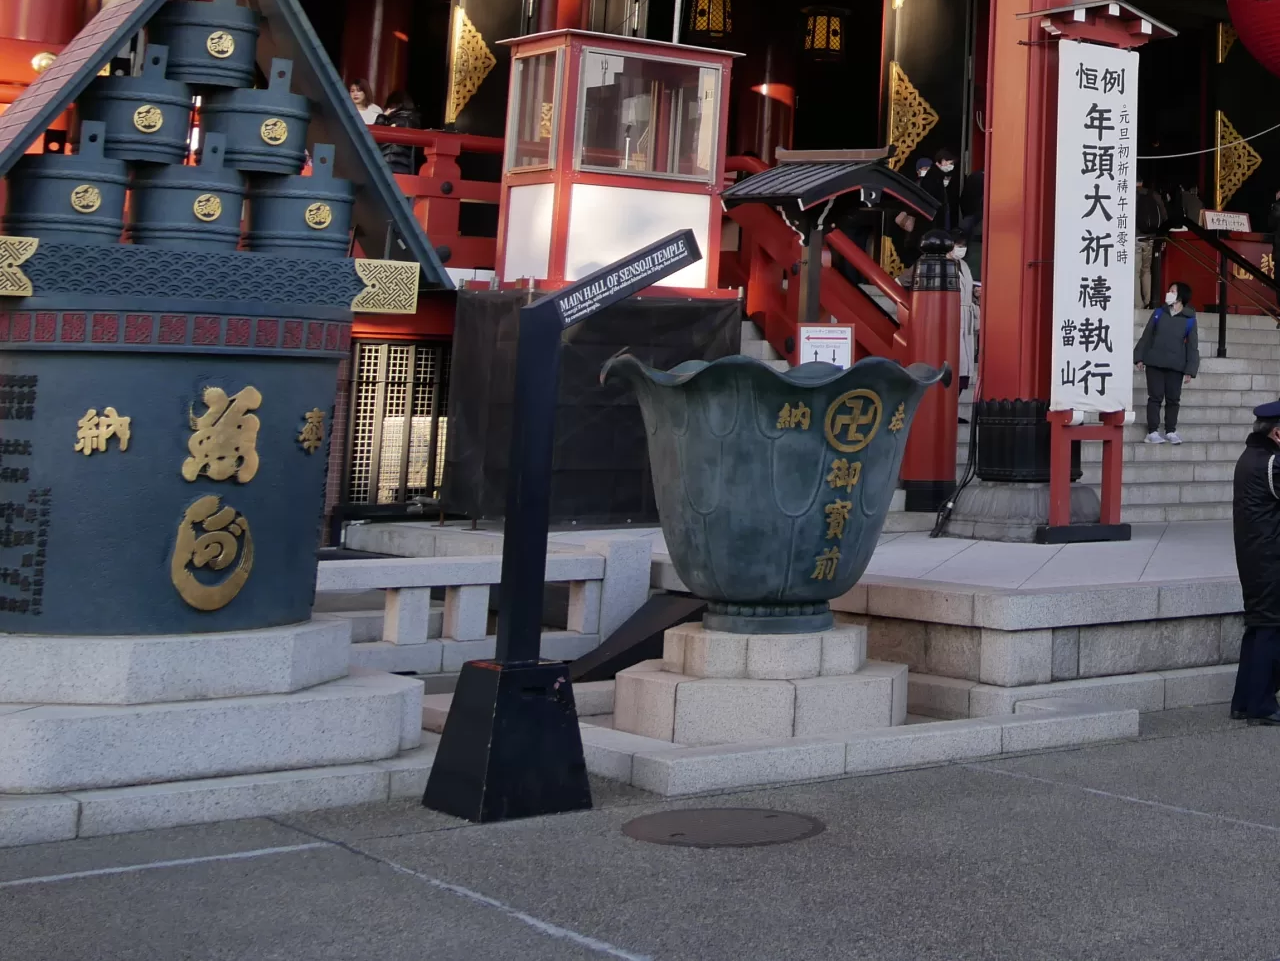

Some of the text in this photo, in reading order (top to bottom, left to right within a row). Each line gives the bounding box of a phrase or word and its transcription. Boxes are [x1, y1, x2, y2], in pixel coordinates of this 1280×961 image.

[1075, 62, 1125, 95] 恒例
[559, 240, 686, 312] MAIN HALL OF SENSOJI TEMPLE
[74, 406, 131, 456] 納
[776, 401, 811, 430] 納
